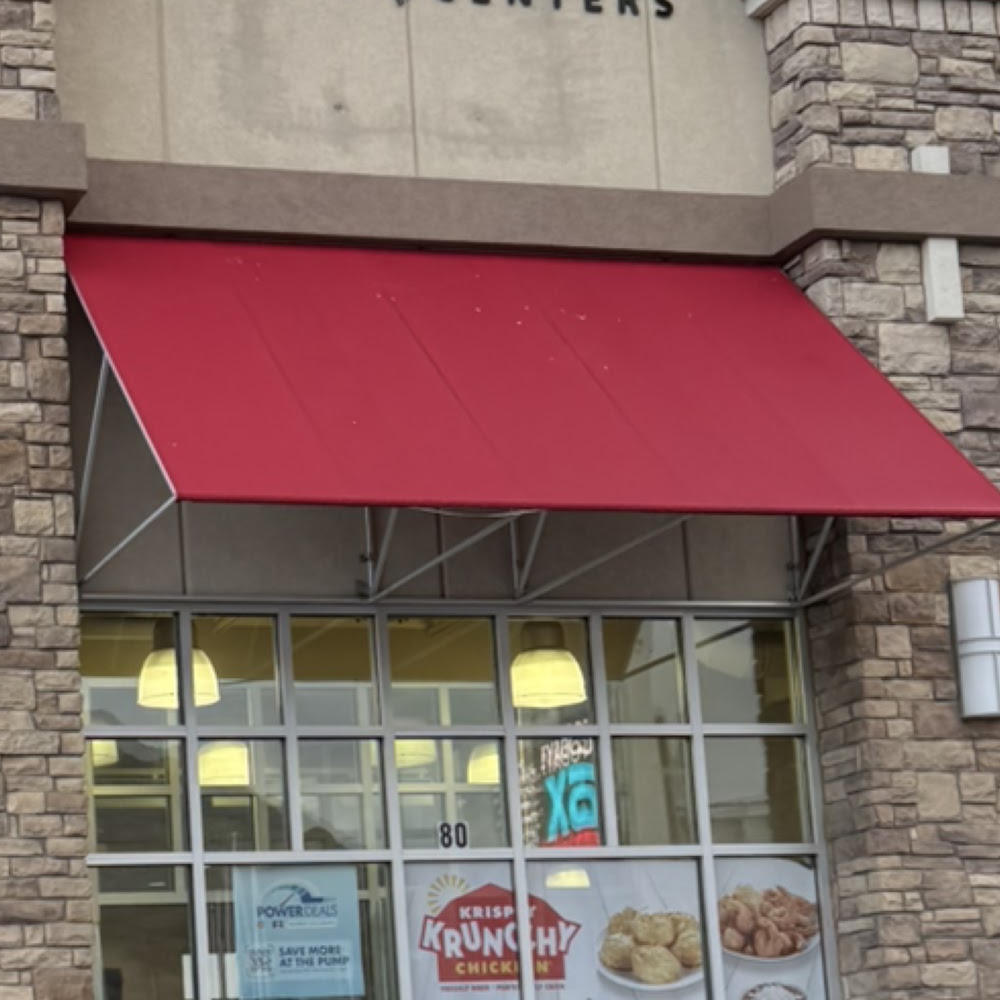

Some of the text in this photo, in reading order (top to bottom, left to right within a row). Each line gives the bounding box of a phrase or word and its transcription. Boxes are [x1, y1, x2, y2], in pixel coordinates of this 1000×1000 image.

[440, 822, 468, 848] 80
[279, 944, 341, 956] SAVE MORE
[455, 961, 549, 975] CHICKN
